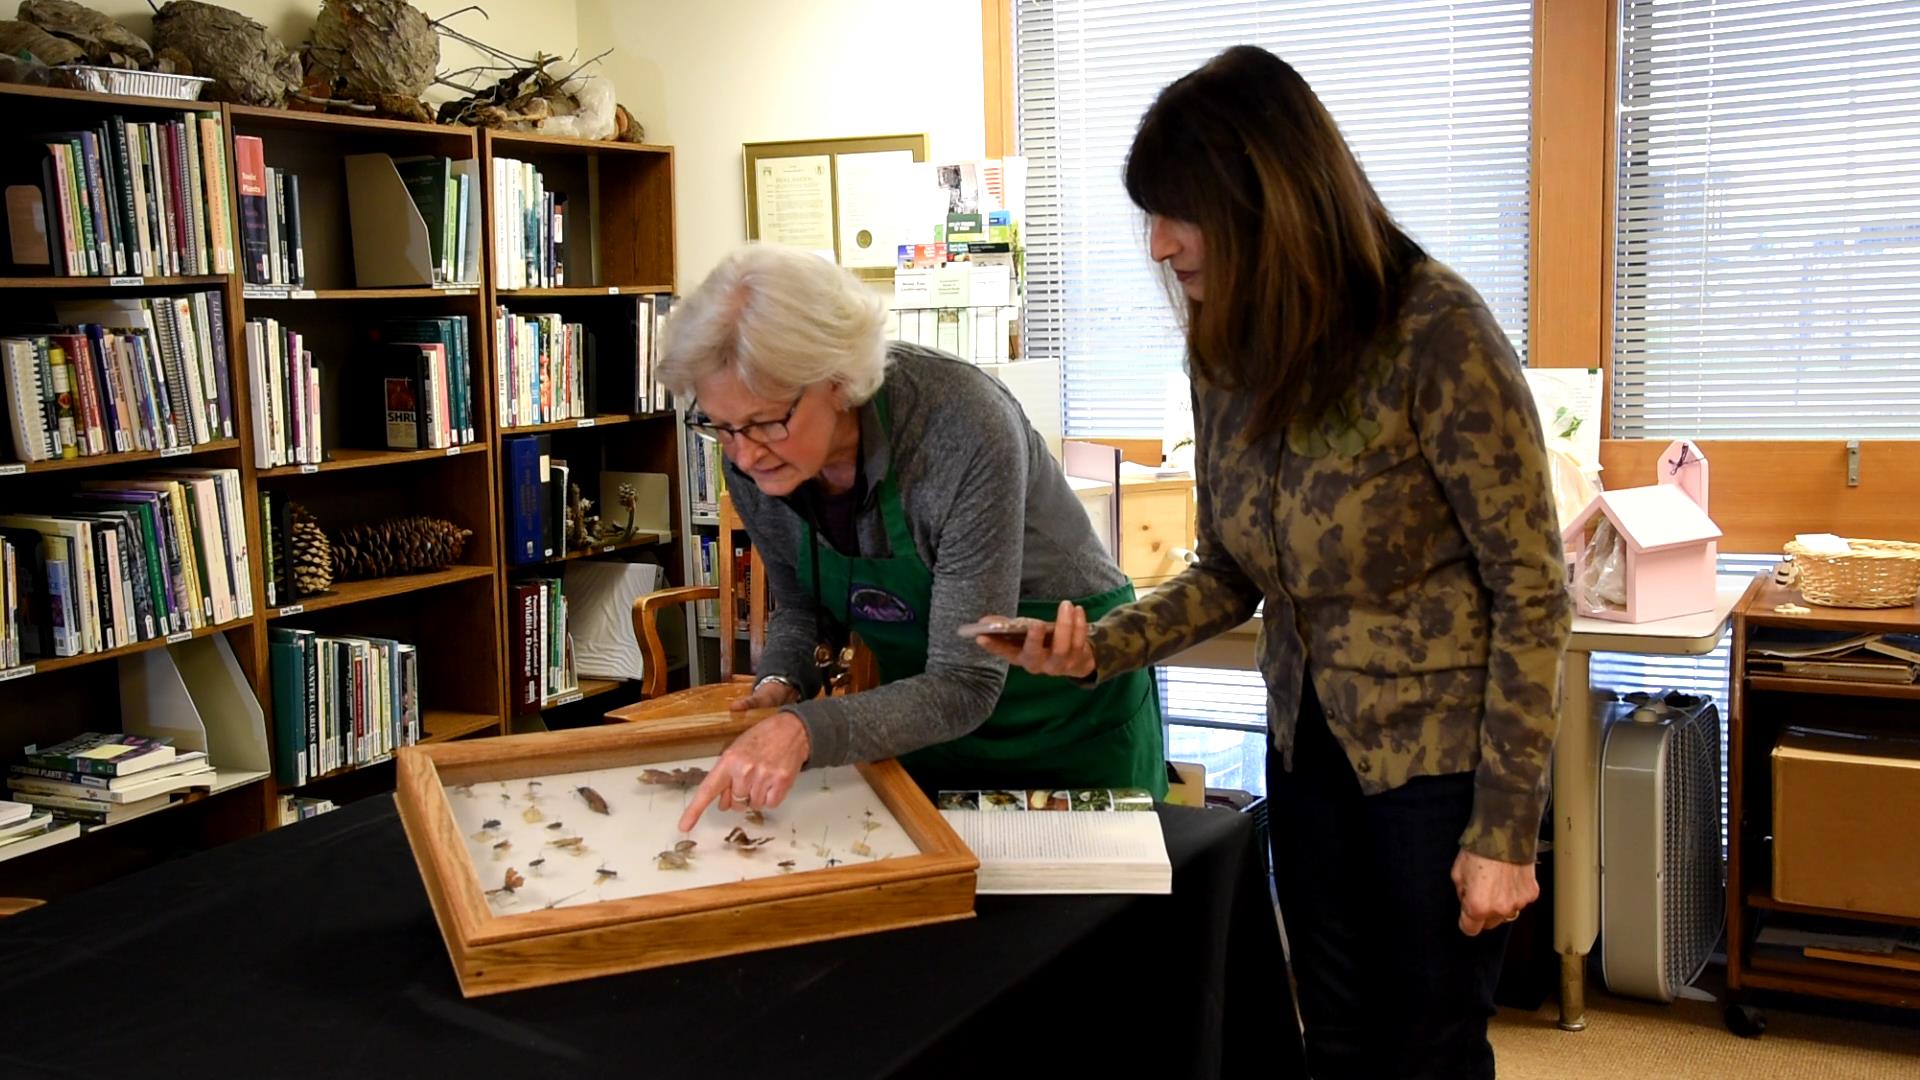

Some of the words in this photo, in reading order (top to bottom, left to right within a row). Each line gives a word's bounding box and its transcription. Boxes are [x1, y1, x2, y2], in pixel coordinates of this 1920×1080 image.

[118, 129, 129, 165] TREES
[124, 179, 136, 223] SHRUBS
[212, 300, 222, 342] LILACS
[387, 411, 433, 424] SHRUS
[524, 595, 534, 636] Wildlife
[524, 637, 533, 677] Damage
[308, 664, 316, 702] WATER
[309, 704, 317, 742] GARDEN
